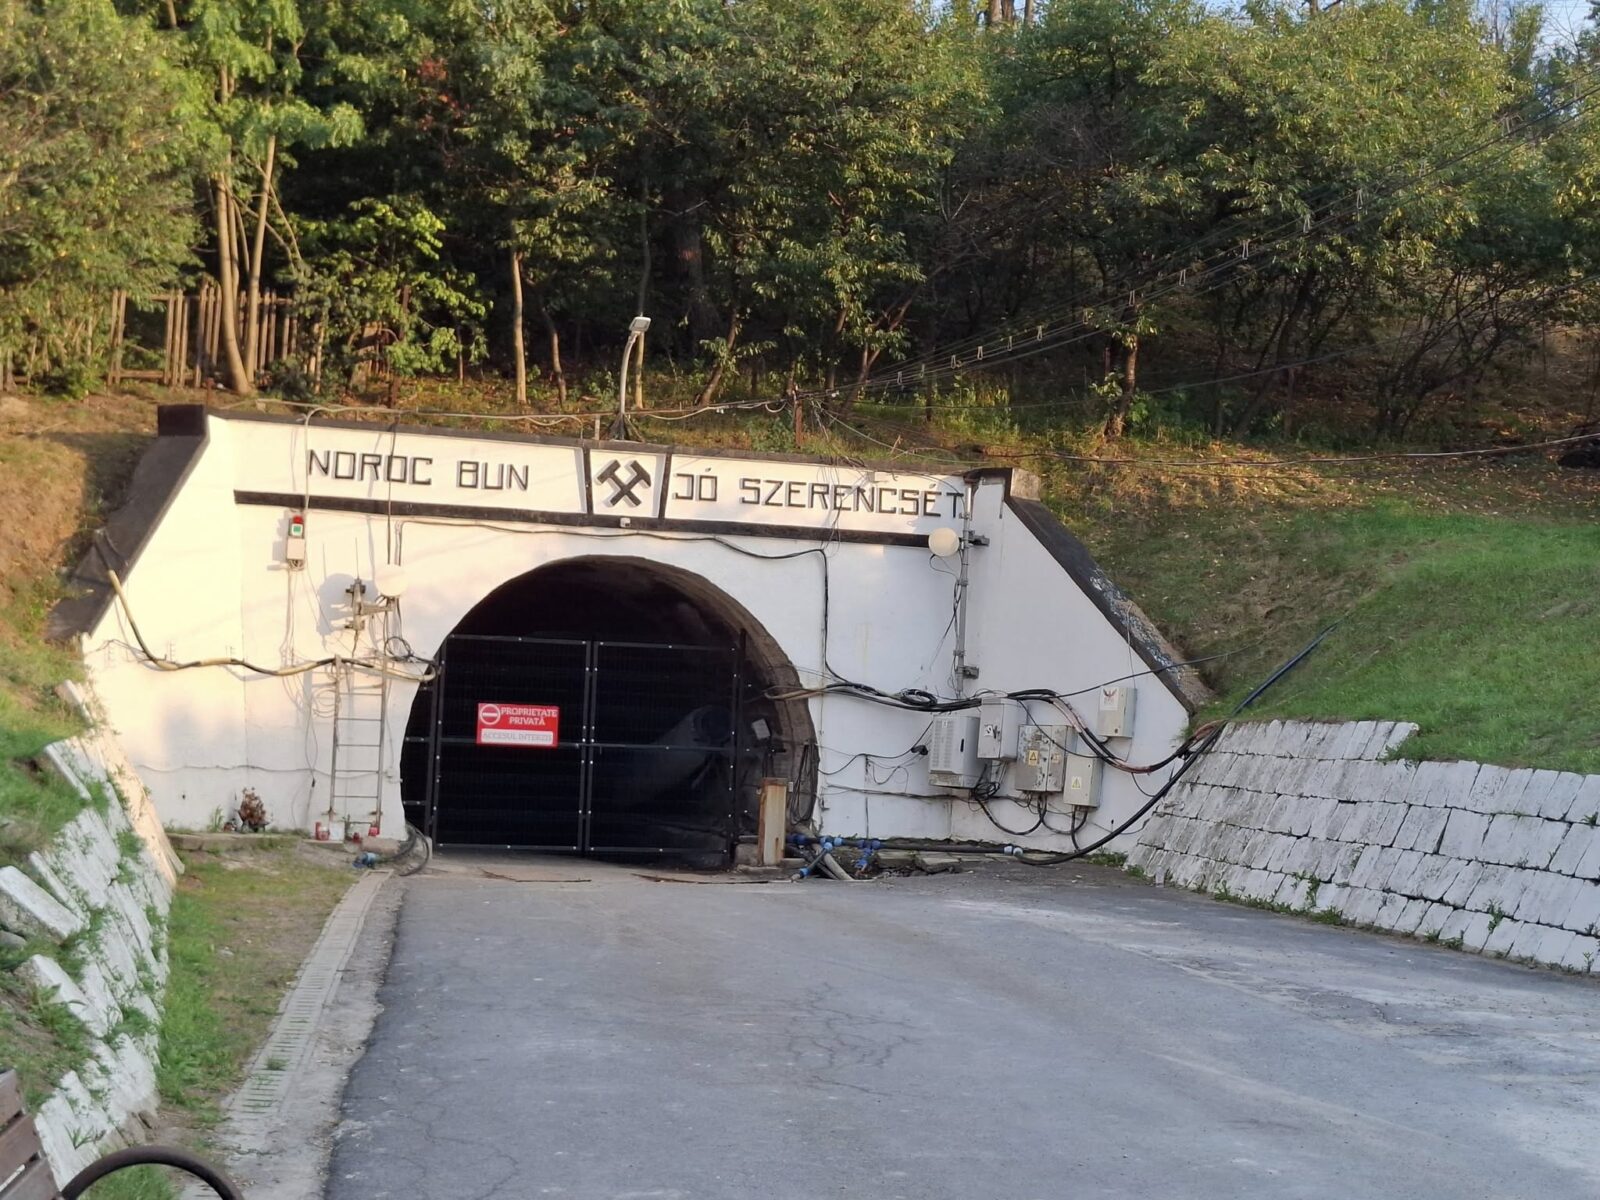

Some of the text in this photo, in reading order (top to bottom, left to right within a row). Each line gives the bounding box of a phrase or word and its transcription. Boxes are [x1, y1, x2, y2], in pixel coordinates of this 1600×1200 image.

[308, 449, 529, 491] NOROC BUN
[672, 467, 964, 519] JÓ SZERENCSÉT
[501, 707, 558, 718] PROPRIETATE
